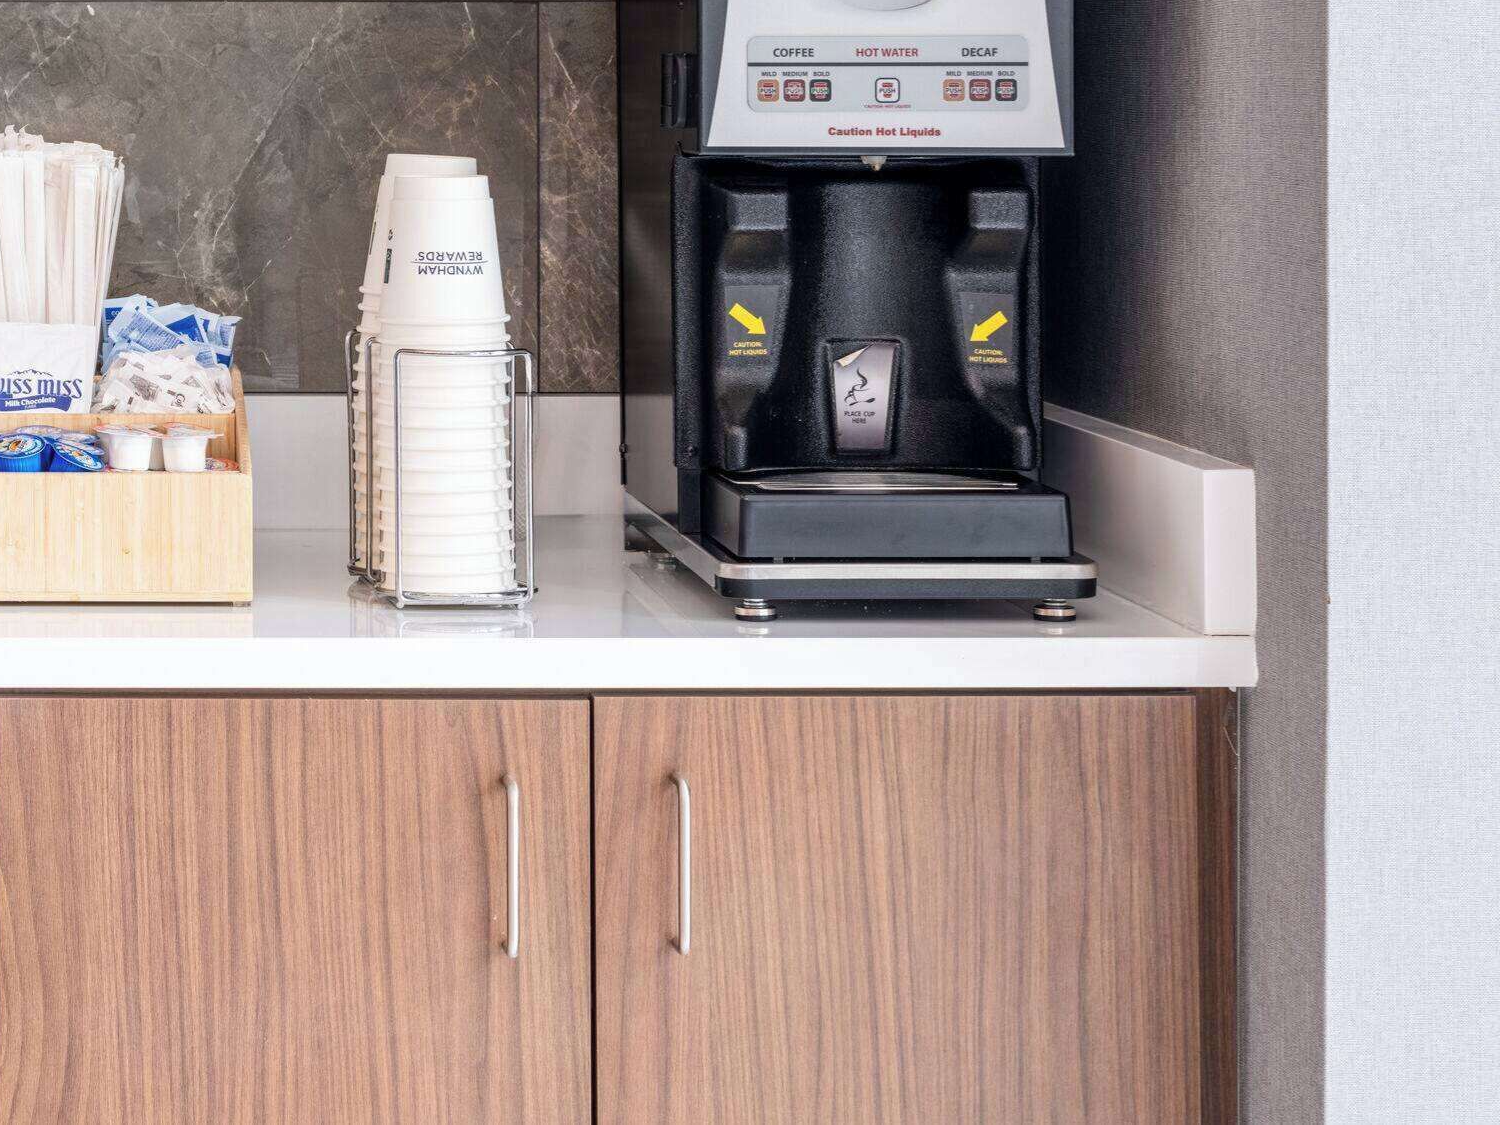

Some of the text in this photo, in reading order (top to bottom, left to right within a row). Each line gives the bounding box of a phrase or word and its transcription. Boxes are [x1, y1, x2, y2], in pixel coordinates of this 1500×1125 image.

[773, 48, 815, 57] COFFEE
[855, 48, 919, 57] HOT WATER
[961, 47, 998, 57] DECAF
[828, 127, 941, 139] Caution Hot Liquids
[416, 251, 483, 261] REWARDS
[417, 265, 484, 275] WYNDHAM
[20, 396, 56, 406] Chocolate
